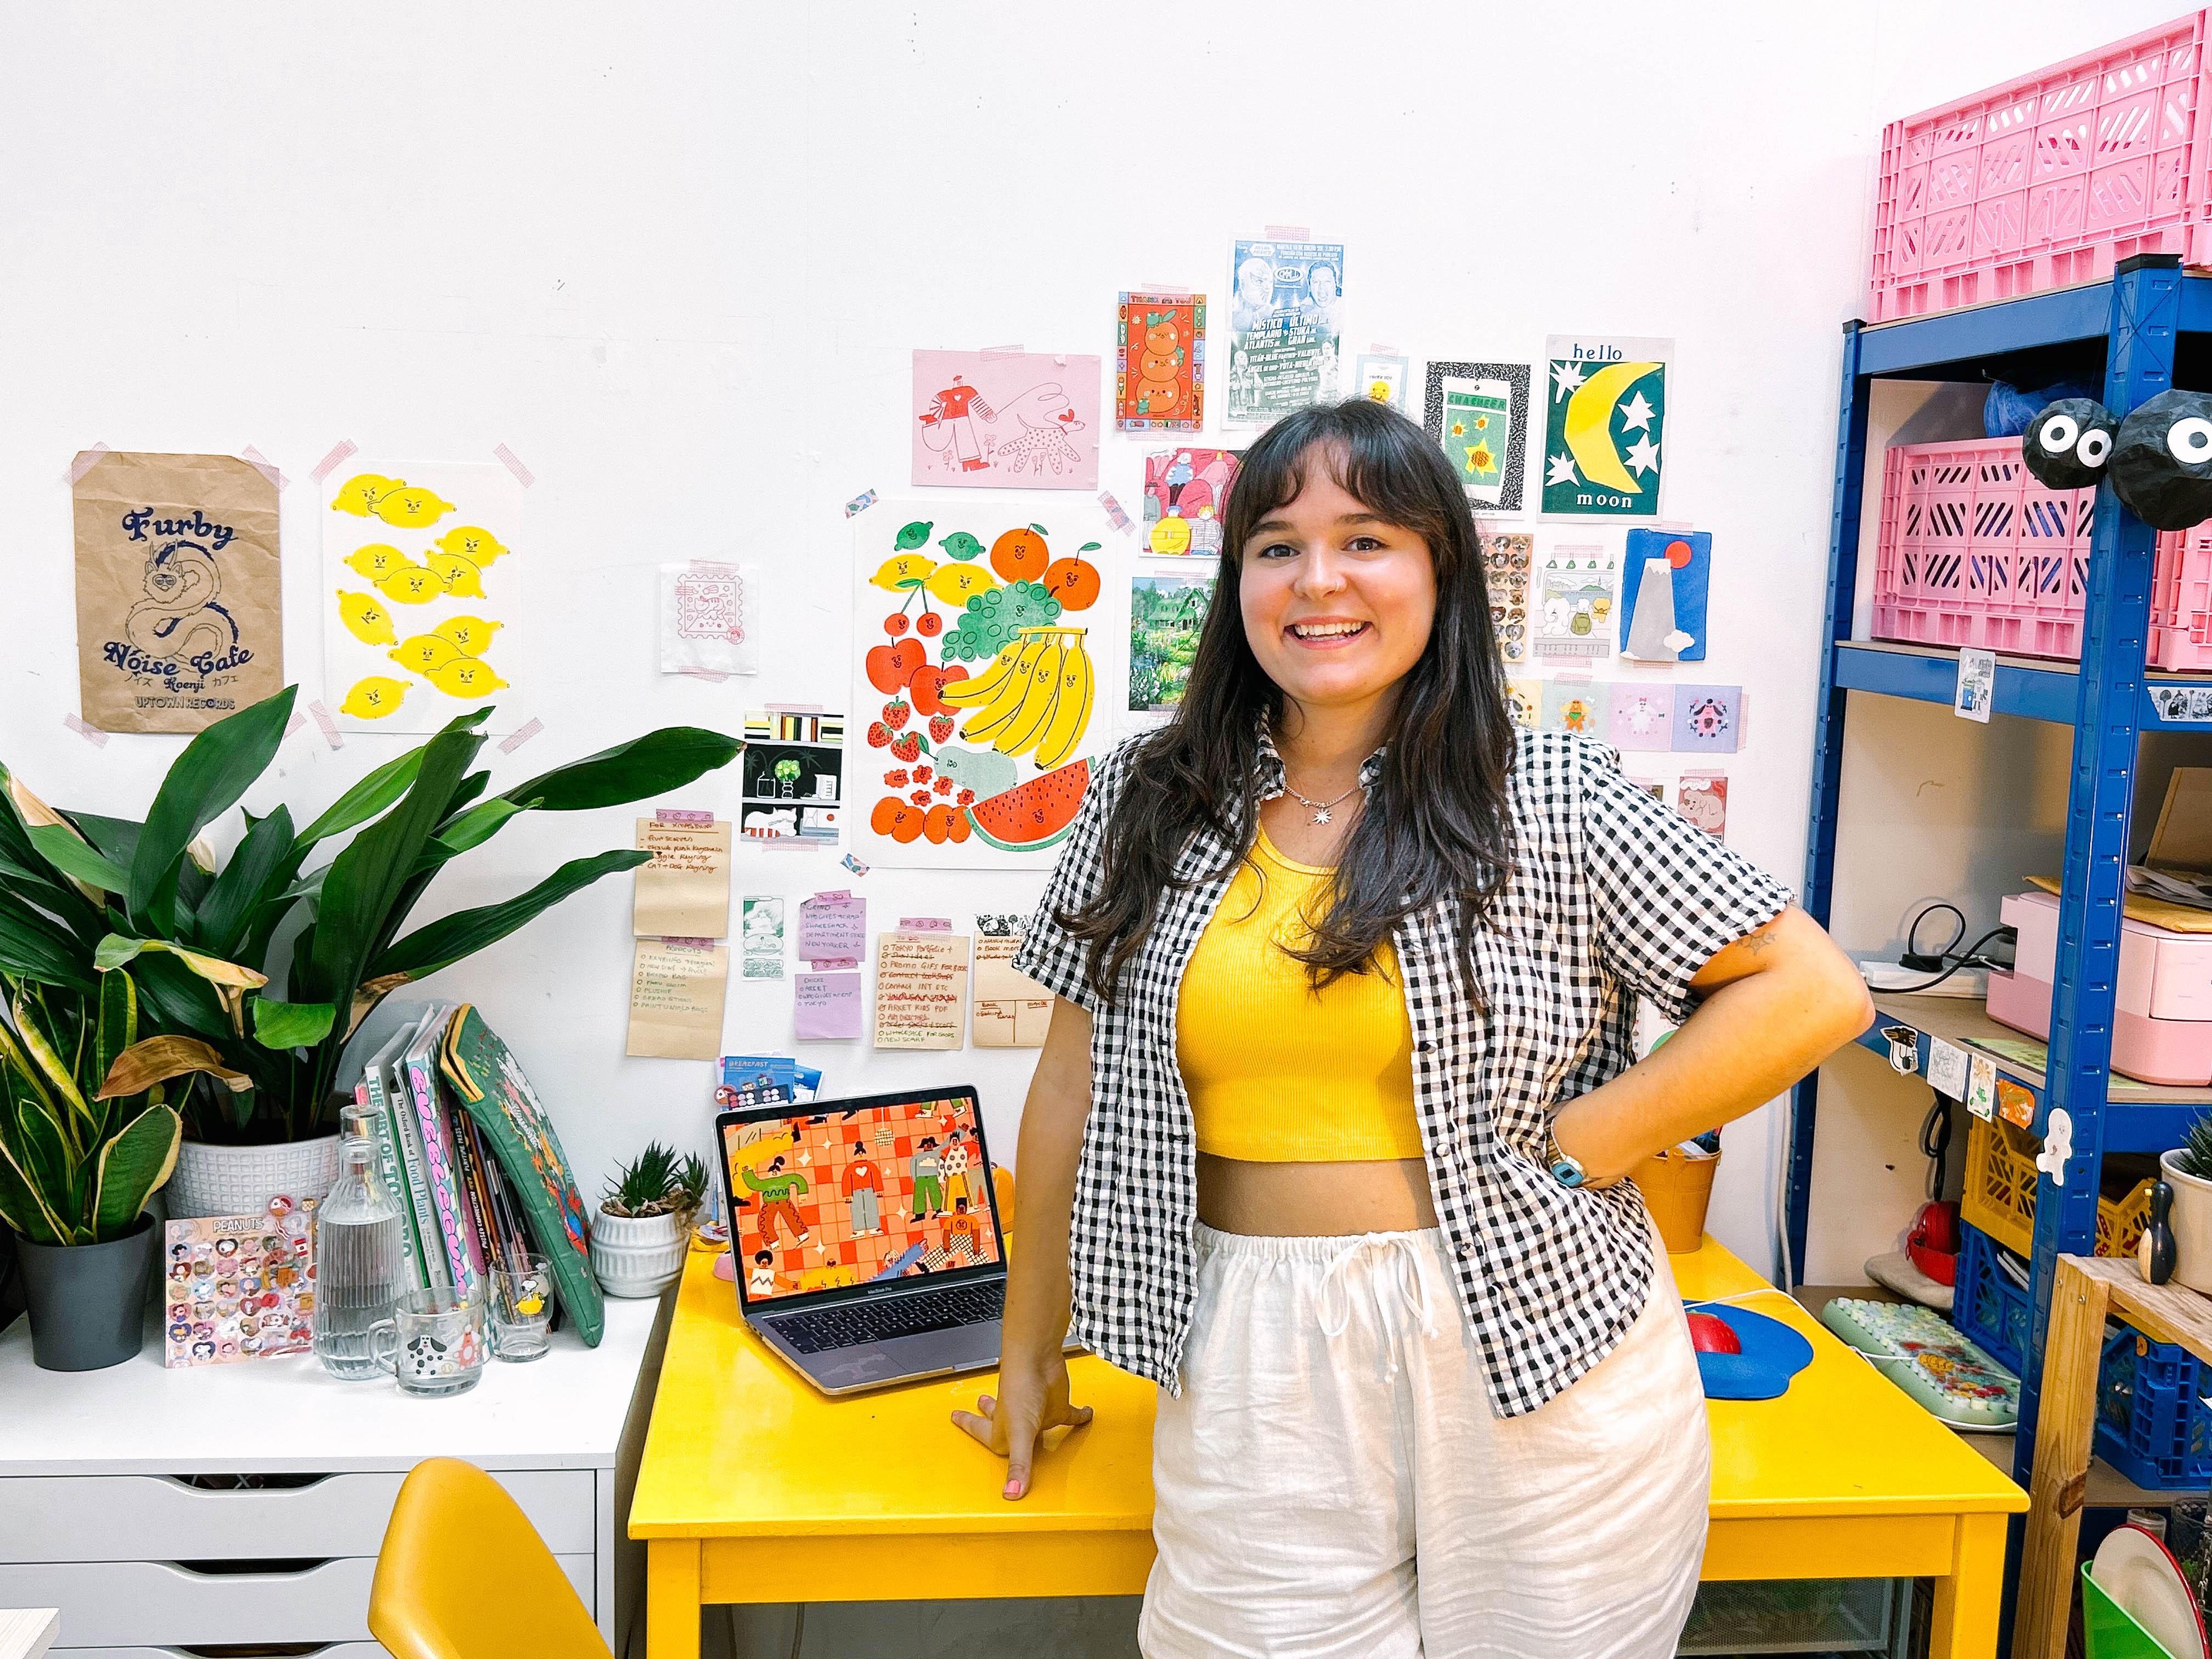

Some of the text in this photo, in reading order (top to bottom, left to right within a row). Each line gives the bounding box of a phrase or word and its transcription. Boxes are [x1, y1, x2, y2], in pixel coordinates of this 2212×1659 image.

[1252, 318, 1284, 331] MÍSTICO
[1290, 314, 1318, 328] ÚLTIMO
[1246, 329, 1282, 341] TEMPLARIO
[1289, 326, 1310, 337] STUKA
[1244, 340, 1274, 350] ATLANTIS
[1288, 335, 1306, 345] GRAN
[1573, 343, 1623, 360] hello
[1576, 494, 1632, 509] moon
[122, 507, 238, 549] Furby
[104, 642, 254, 679] Noise Cafe
[135, 696, 235, 709] UPTOWN RECORDS
[890, 961, 917, 969] PROMO
[369, 1076, 385, 1107] THE
[378, 1110, 390, 1140] ART
[381, 1143, 394, 1166] OF
[407, 1157, 424, 1187] Food
[414, 1188, 430, 1224] Plants
[212, 1217, 264, 1234] PEANUTS
